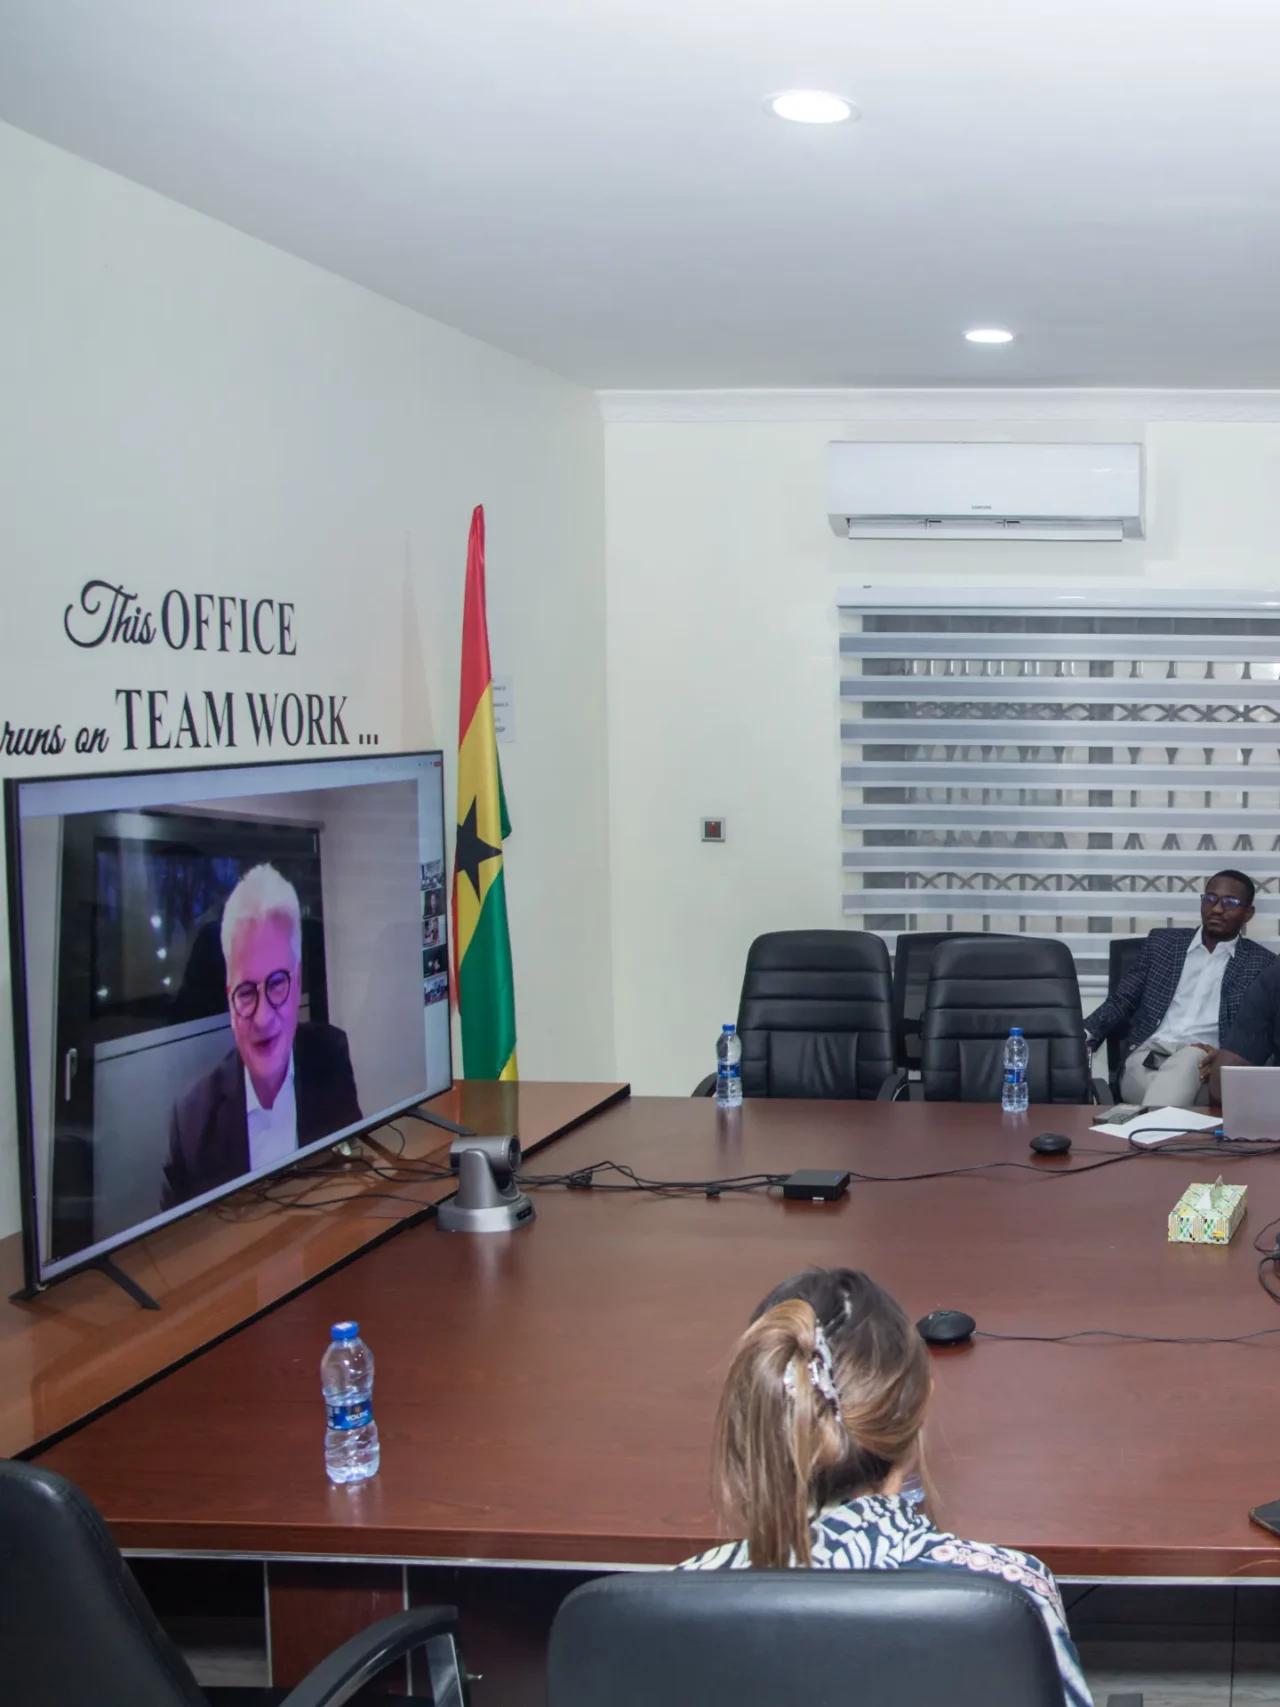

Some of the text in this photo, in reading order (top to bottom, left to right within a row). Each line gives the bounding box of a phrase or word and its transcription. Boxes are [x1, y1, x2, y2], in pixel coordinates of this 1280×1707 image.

[64, 579, 297, 656] This OFFICE
[0, 721, 66, 756] runs
[75, 726, 110, 754] on
[115, 689, 237, 751] TEAM
